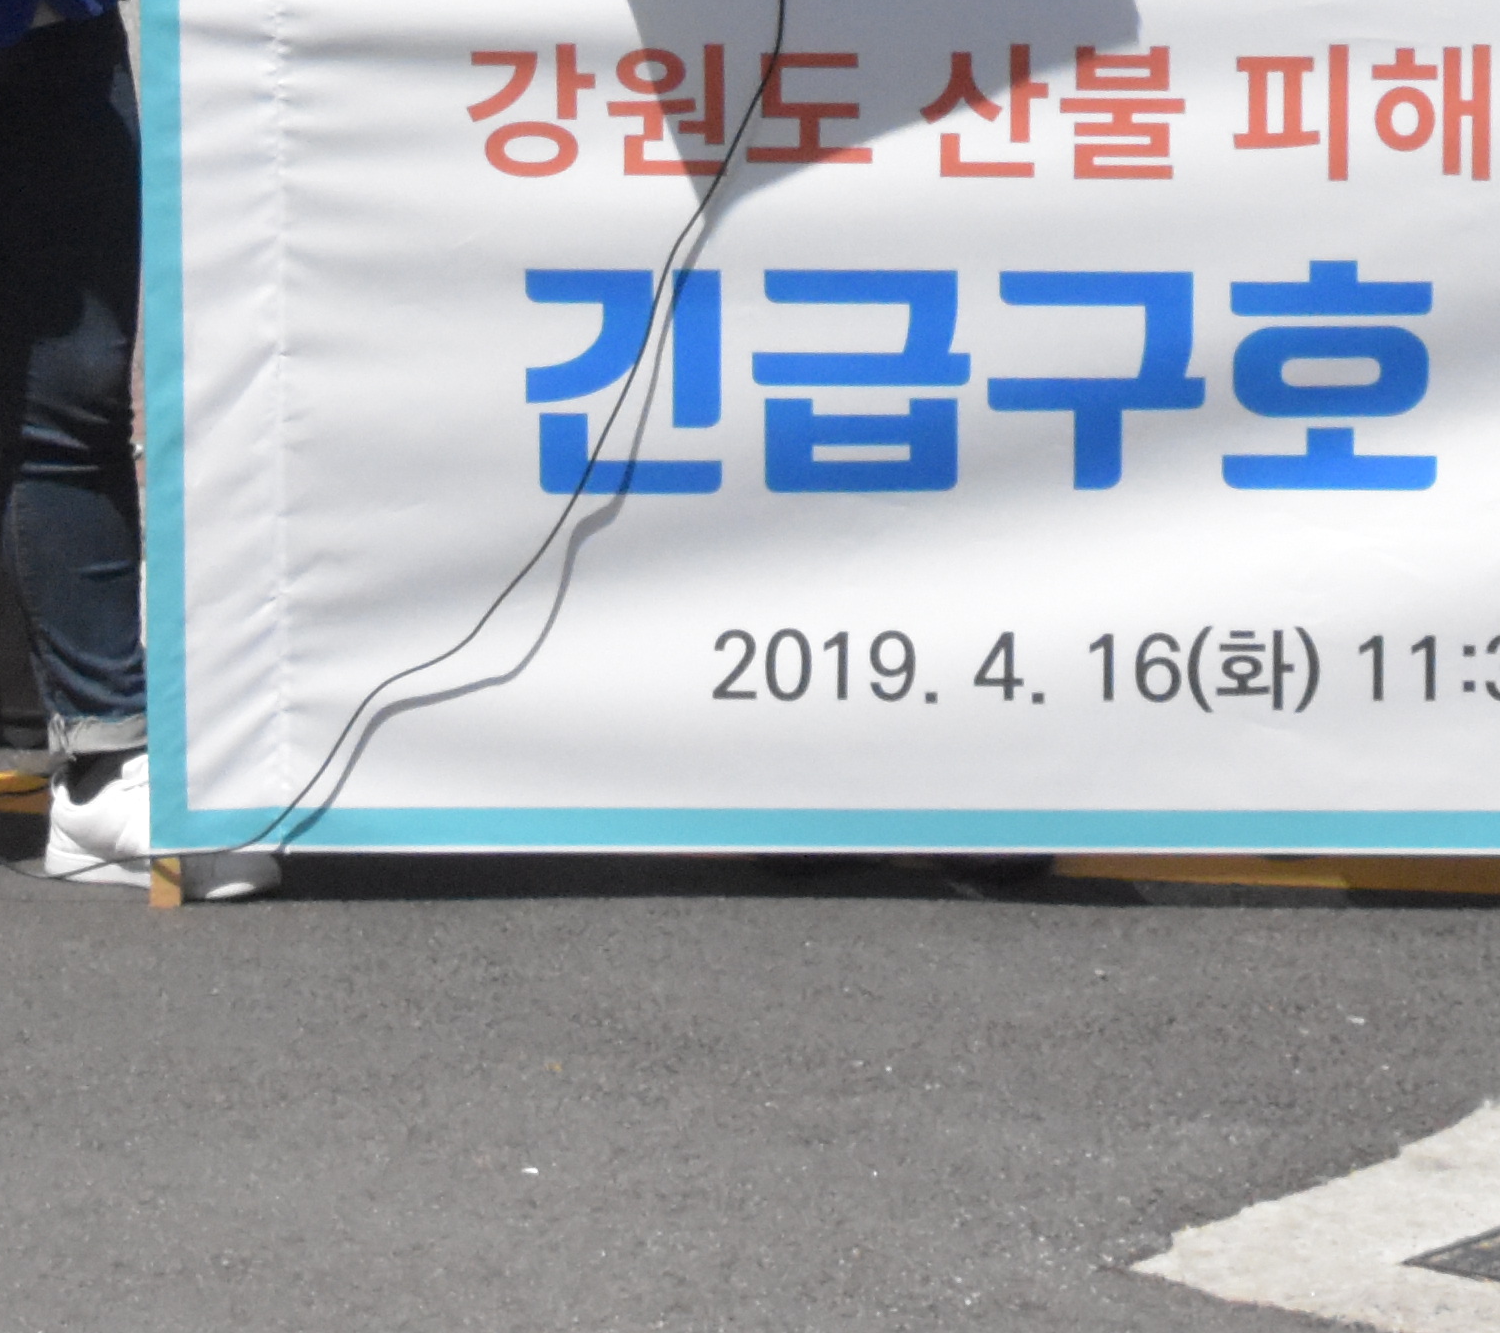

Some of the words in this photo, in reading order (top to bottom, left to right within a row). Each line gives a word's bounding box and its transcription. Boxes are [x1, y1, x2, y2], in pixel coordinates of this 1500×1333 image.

[466, 42, 874, 179] 강원도
[920, 43, 1186, 181] 산불
[1232, 44, 1492, 183] 피해
[524, 259, 1438, 495] 긴급구호
[711, 627, 939, 706] 2019.
[973, 629, 1046, 706] 4.
[1088, 626, 1320, 716] 16(화)
